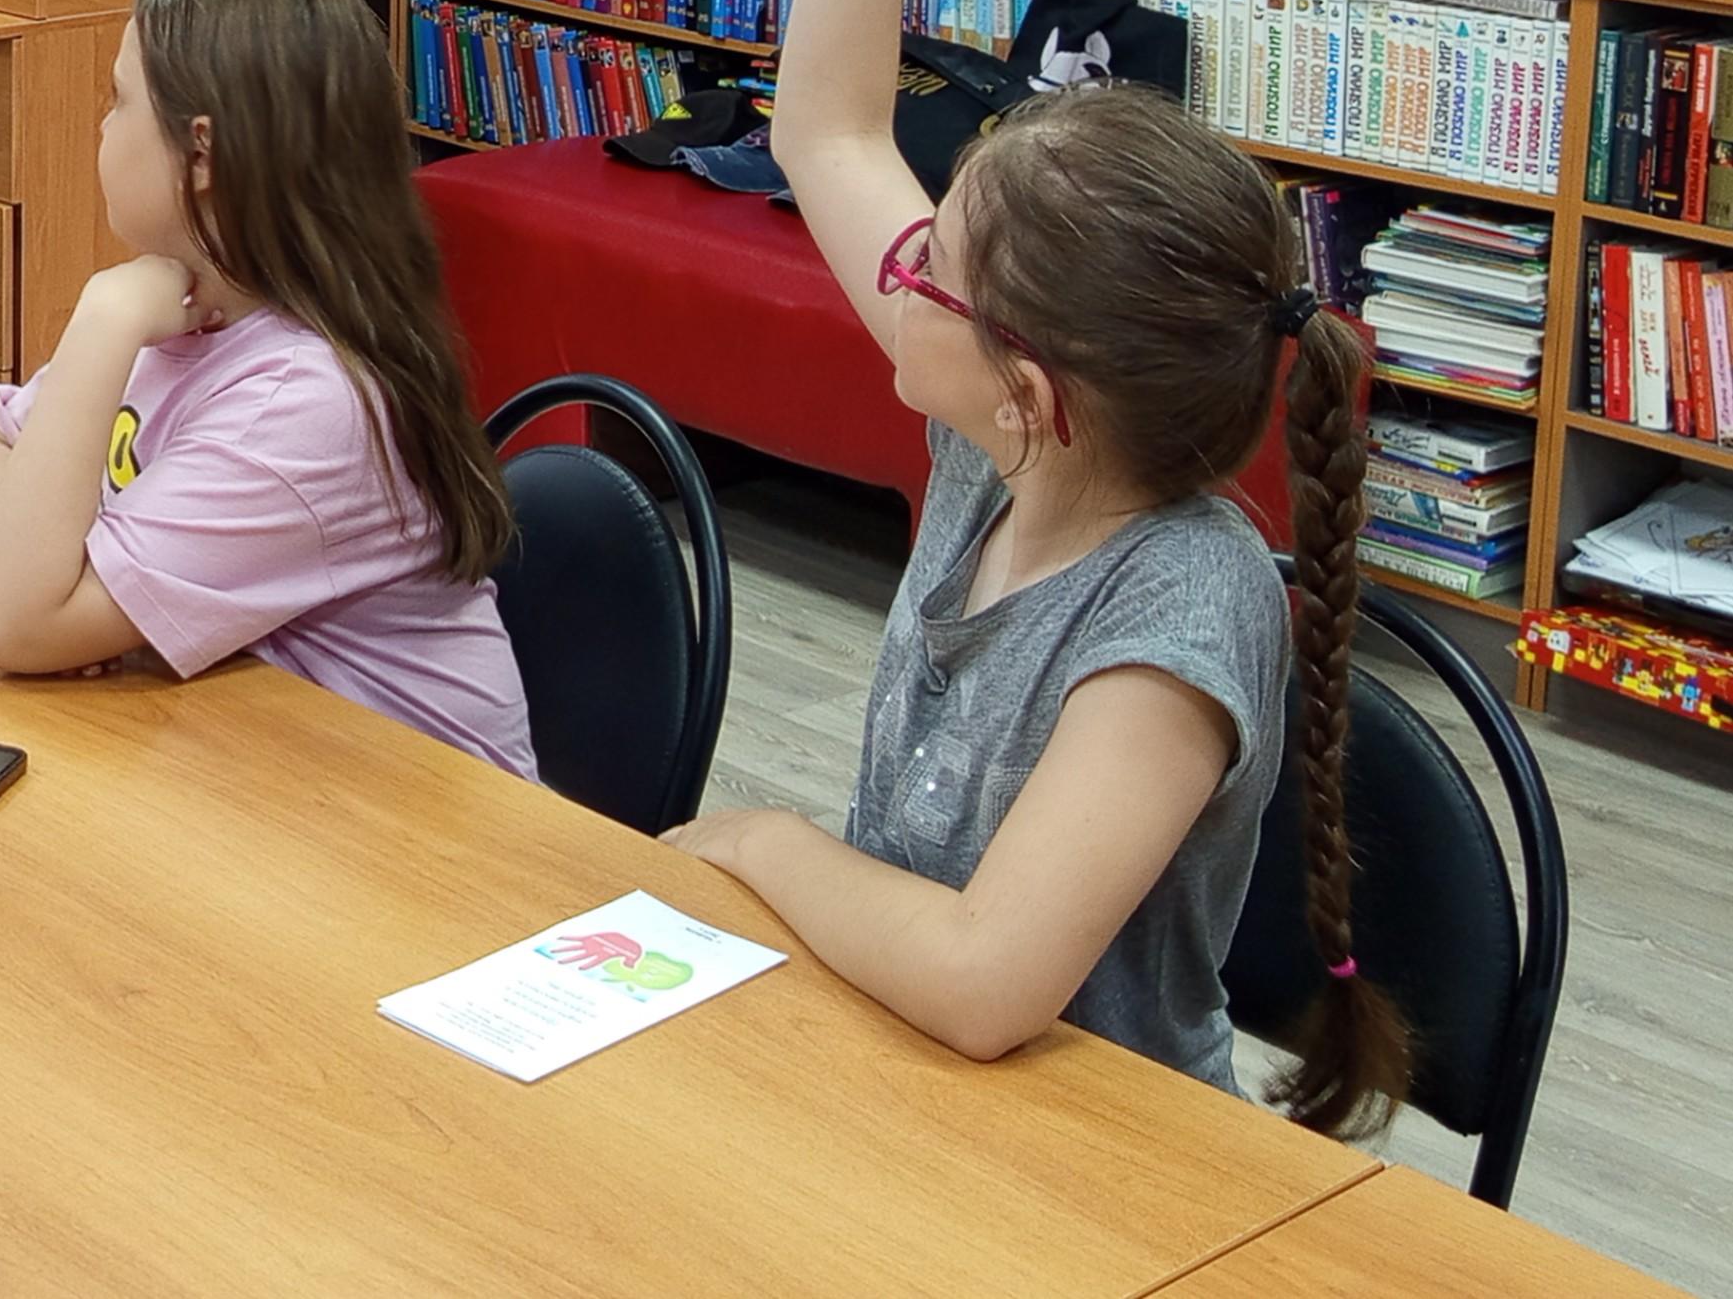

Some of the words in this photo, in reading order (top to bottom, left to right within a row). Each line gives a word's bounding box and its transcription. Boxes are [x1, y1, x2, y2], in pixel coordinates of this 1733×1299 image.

[1268, 25, 1283, 59] МИР
[1328, 32, 1342, 65] МИР
[1350, 26, 1365, 60] МИР
[1437, 39, 1453, 74] МИР
[1473, 46, 1488, 83] МИР
[1454, 50, 1468, 83] МИР
[1493, 57, 1508, 91] МИР
[1510, 61, 1526, 95] МИР
[1531, 61, 1546, 95] МИР
[1555, 58, 1568, 92] МИР
[1265, 60, 1281, 122] ПОЗНАЮ
[1325, 67, 1340, 127] ПОЗНАЮ
[1348, 63, 1364, 128] ПОЗНАЮ
[1434, 78, 1452, 143] ПОЗНАЮ
[1451, 84, 1466, 146] ПОЗНАЮ
[1467, 86, 1485, 152] ПОЗНАЮ
[1488, 92, 1505, 154] ПОЗНАЮ
[1507, 96, 1523, 158] ПОЗНАЮ
[1527, 96, 1542, 160] ПОЗНАЮ
[1550, 96, 1566, 160] ПОЗНАЮ
